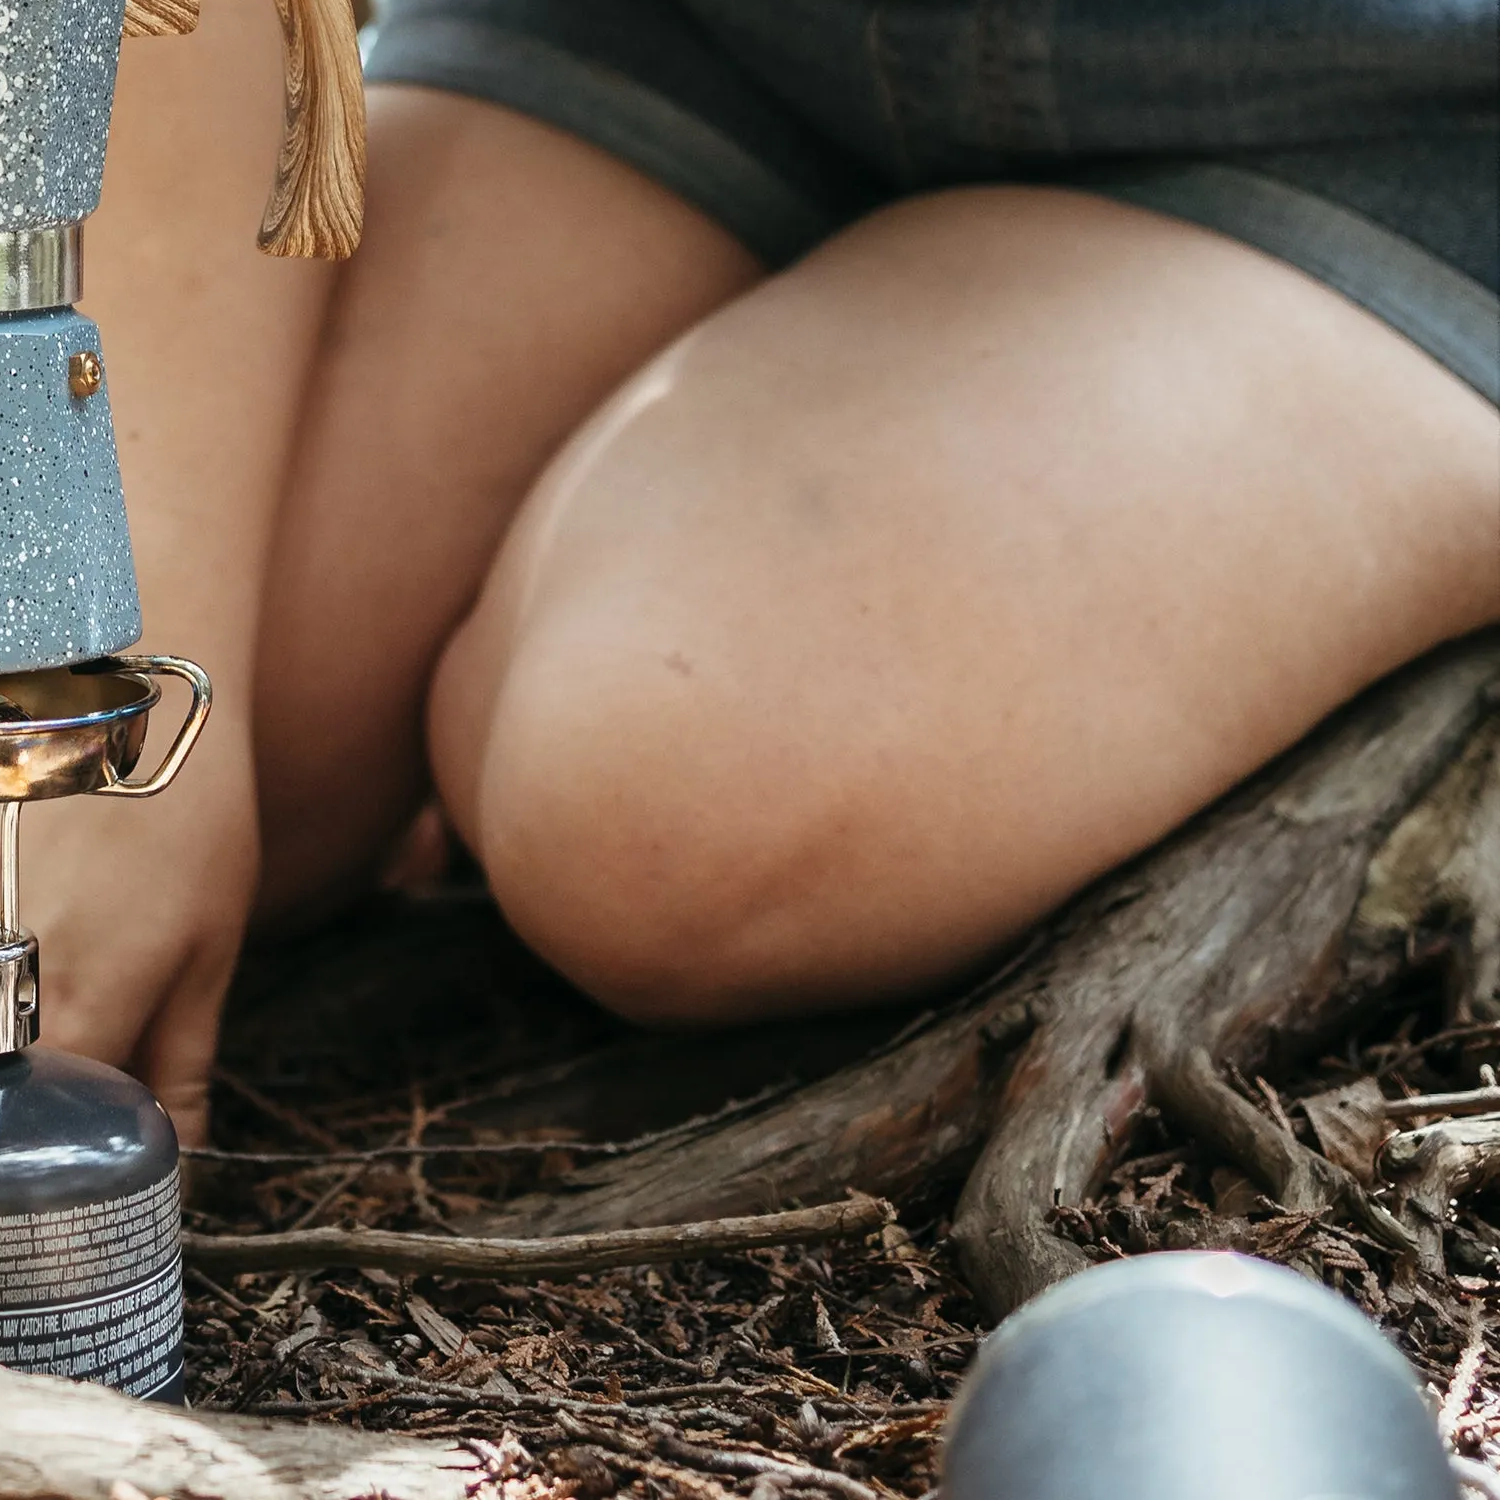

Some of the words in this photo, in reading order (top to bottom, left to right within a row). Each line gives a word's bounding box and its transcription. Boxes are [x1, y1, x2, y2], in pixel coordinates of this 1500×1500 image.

[31, 1213, 40, 1225] Do
[40, 1212, 50, 1223] not
[74, 1206, 83, 1218] fire
[83, 1207, 90, 1217] or
[33, 1224, 57, 1239] ALWAYS
[57, 1222, 73, 1236] READ
[73, 1219, 85, 1233] AND
[85, 1215, 105, 1231] FOLLOW
[105, 1208, 129, 1227] APPLIANCE
[34, 1241, 43, 1254] TO
[43, 1237, 68, 1252] SUSTAIN
[91, 1226, 118, 1245] CONTAINER
[118, 1224, 123, 1238] IS
[101, 1244, 107, 1258] du
[64, 1266, 75, 1281] LES
[75, 1257, 110, 1280] INSTRUCTIONS
[2, 1288, 32, 1304] PRESSION
[50, 1284, 61, 1299] PAS
[61, 1278, 93, 1299] SUFFISANTE
[92, 1275, 106, 1293] POUR
[3, 1318, 19, 1338] MAY
[20, 1316, 43, 1337] CATCH
[44, 1313, 61, 1334] FIRE.
[62, 1306, 97, 1332] CONTAINER
[98, 1302, 110, 1323] MAY
[111, 1294, 135, 1320] EXPLODE
[135, 1292, 140, 1310] IF
[0, 1345, 17, 1362] area.
[18, 1340, 35, 1365] Keep
[36, 1341, 55, 1363] away
[55, 1335, 71, 1356] from
[72, 1329, 94, 1355] flames,
[95, 1325, 109, 1347] such
[110, 1325, 117, 1341] as
[117, 1324, 121, 1339] a
[122, 1315, 134, 1339] pilot
[50, 1350, 98, 1378] S'ENFLAMMER.
[98, 1347, 107, 1367] CE
[107, 1333, 139, 1364] CONTENANT
[139, 1327, 151, 1350] PEUT
[119, 1358, 133, 1381] Tenir
[133, 1353, 143, 1374] loin
